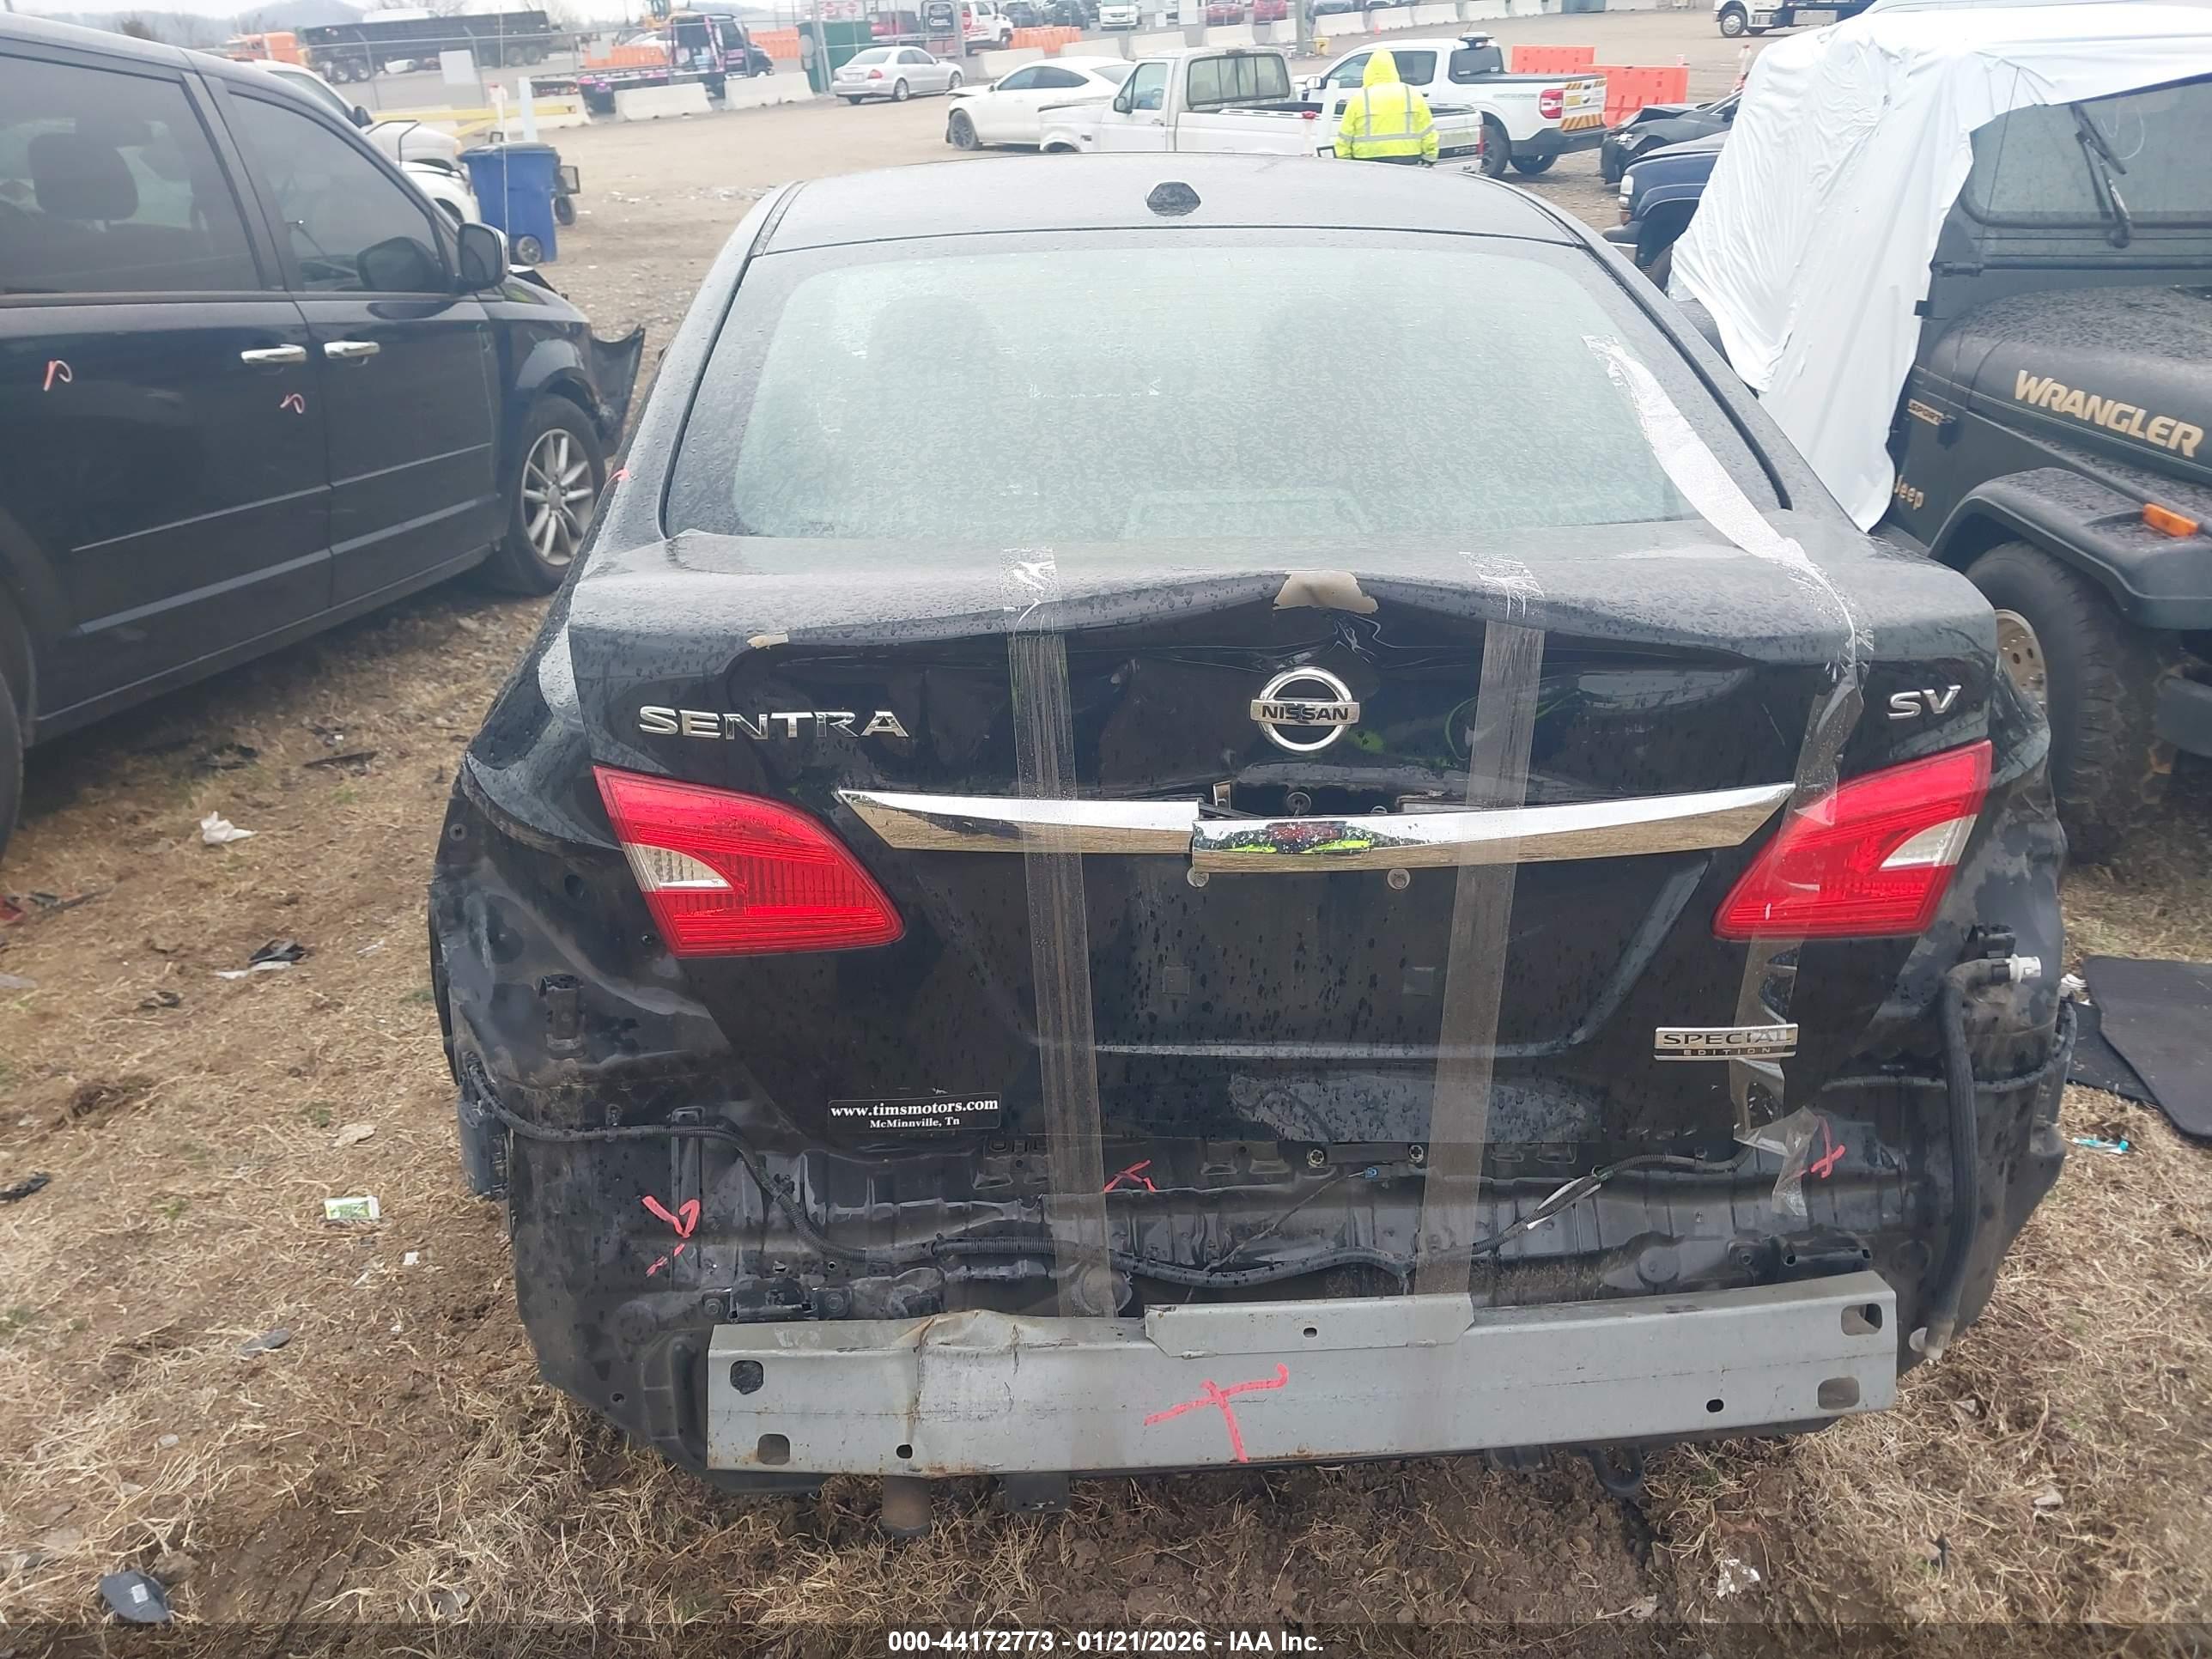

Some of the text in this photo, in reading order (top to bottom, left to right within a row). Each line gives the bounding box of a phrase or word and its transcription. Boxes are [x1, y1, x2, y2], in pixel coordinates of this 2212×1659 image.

[1909, 400, 1944, 424] SPORT
[2014, 369, 2204, 459] WRANGLER
[1894, 474, 1924, 510] Jeep
[1261, 705, 1349, 720] NISSAN
[1887, 684, 1962, 720] SV
[638, 705, 909, 740] SENTRA
[1662, 1029, 1792, 1045] SPECIAL
[1683, 1047, 1771, 1056] EDITION
[830, 1098, 999, 1116] www.timsmotors.com
[869, 1116, 961, 1129] McMinnville, Tn
